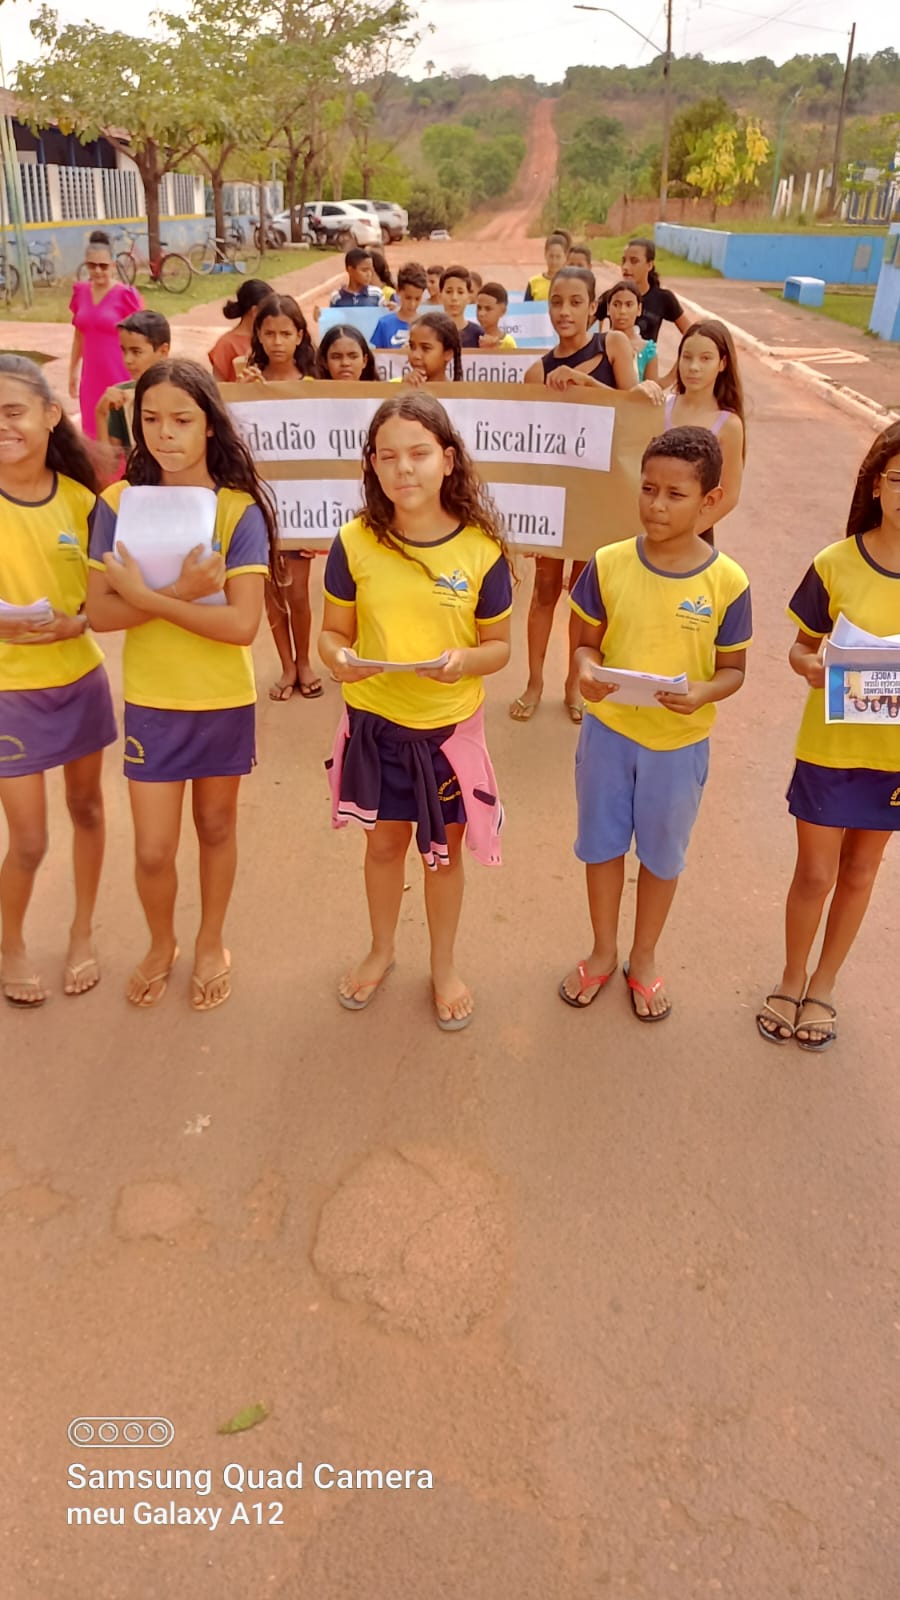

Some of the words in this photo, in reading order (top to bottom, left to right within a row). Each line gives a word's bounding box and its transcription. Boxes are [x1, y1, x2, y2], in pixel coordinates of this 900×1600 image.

[475, 420, 567, 456] fiscaliza
[574, 427, 586, 458] é
[277, 500, 356, 529] idadão
